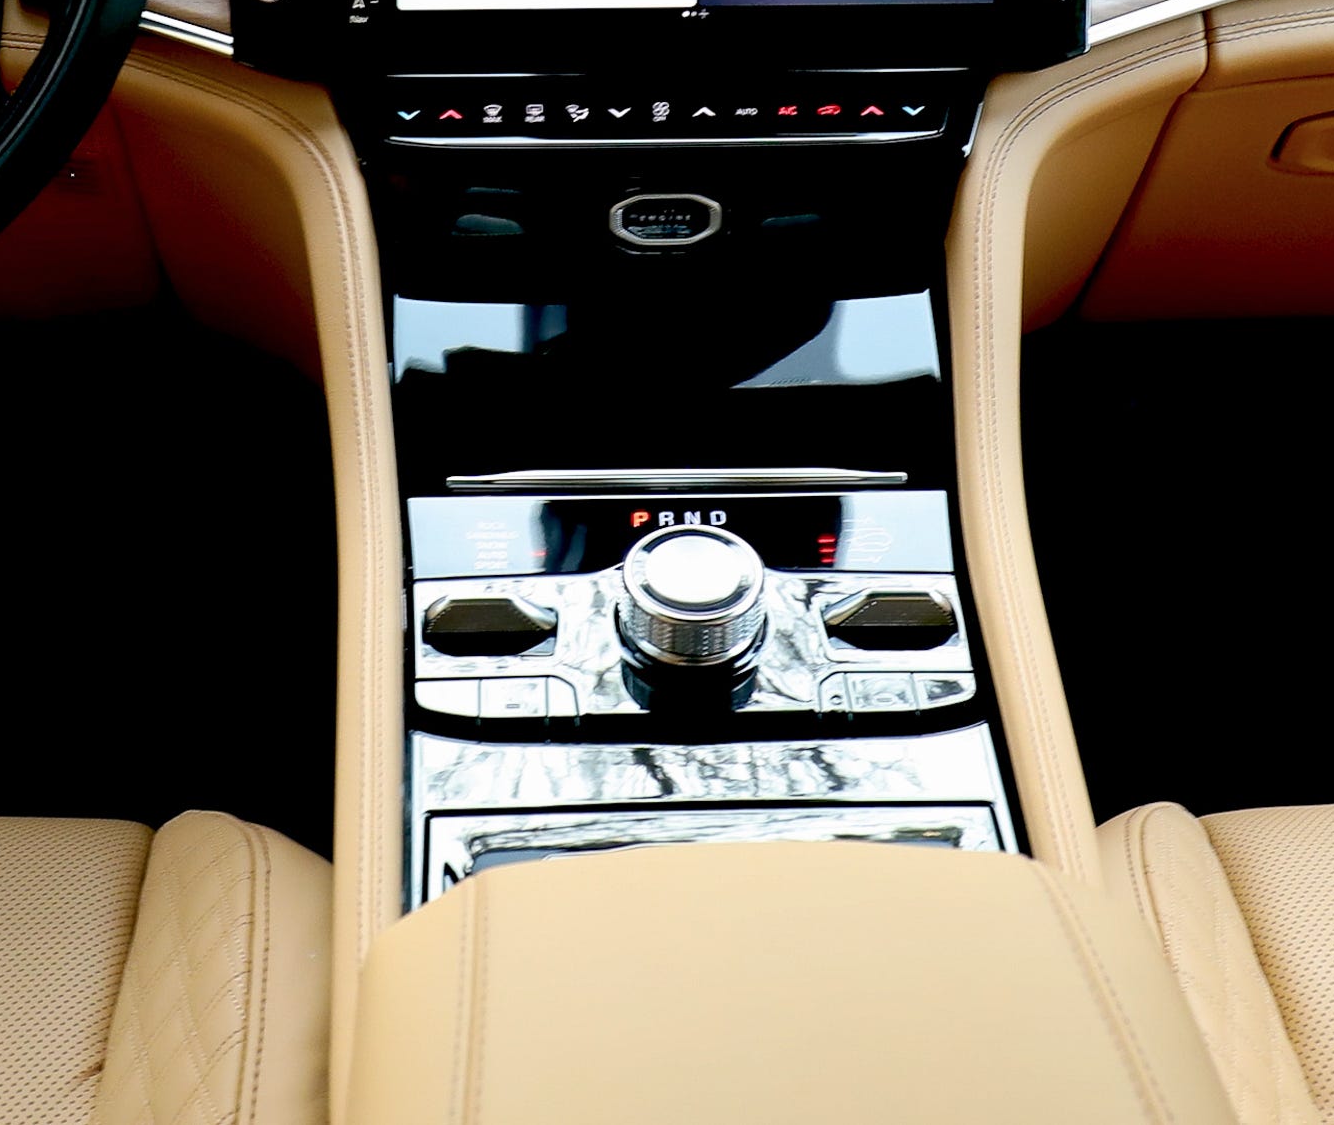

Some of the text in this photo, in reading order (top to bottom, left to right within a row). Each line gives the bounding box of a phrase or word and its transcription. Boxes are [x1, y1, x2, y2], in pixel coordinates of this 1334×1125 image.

[633, 510, 727, 527] P R N D
